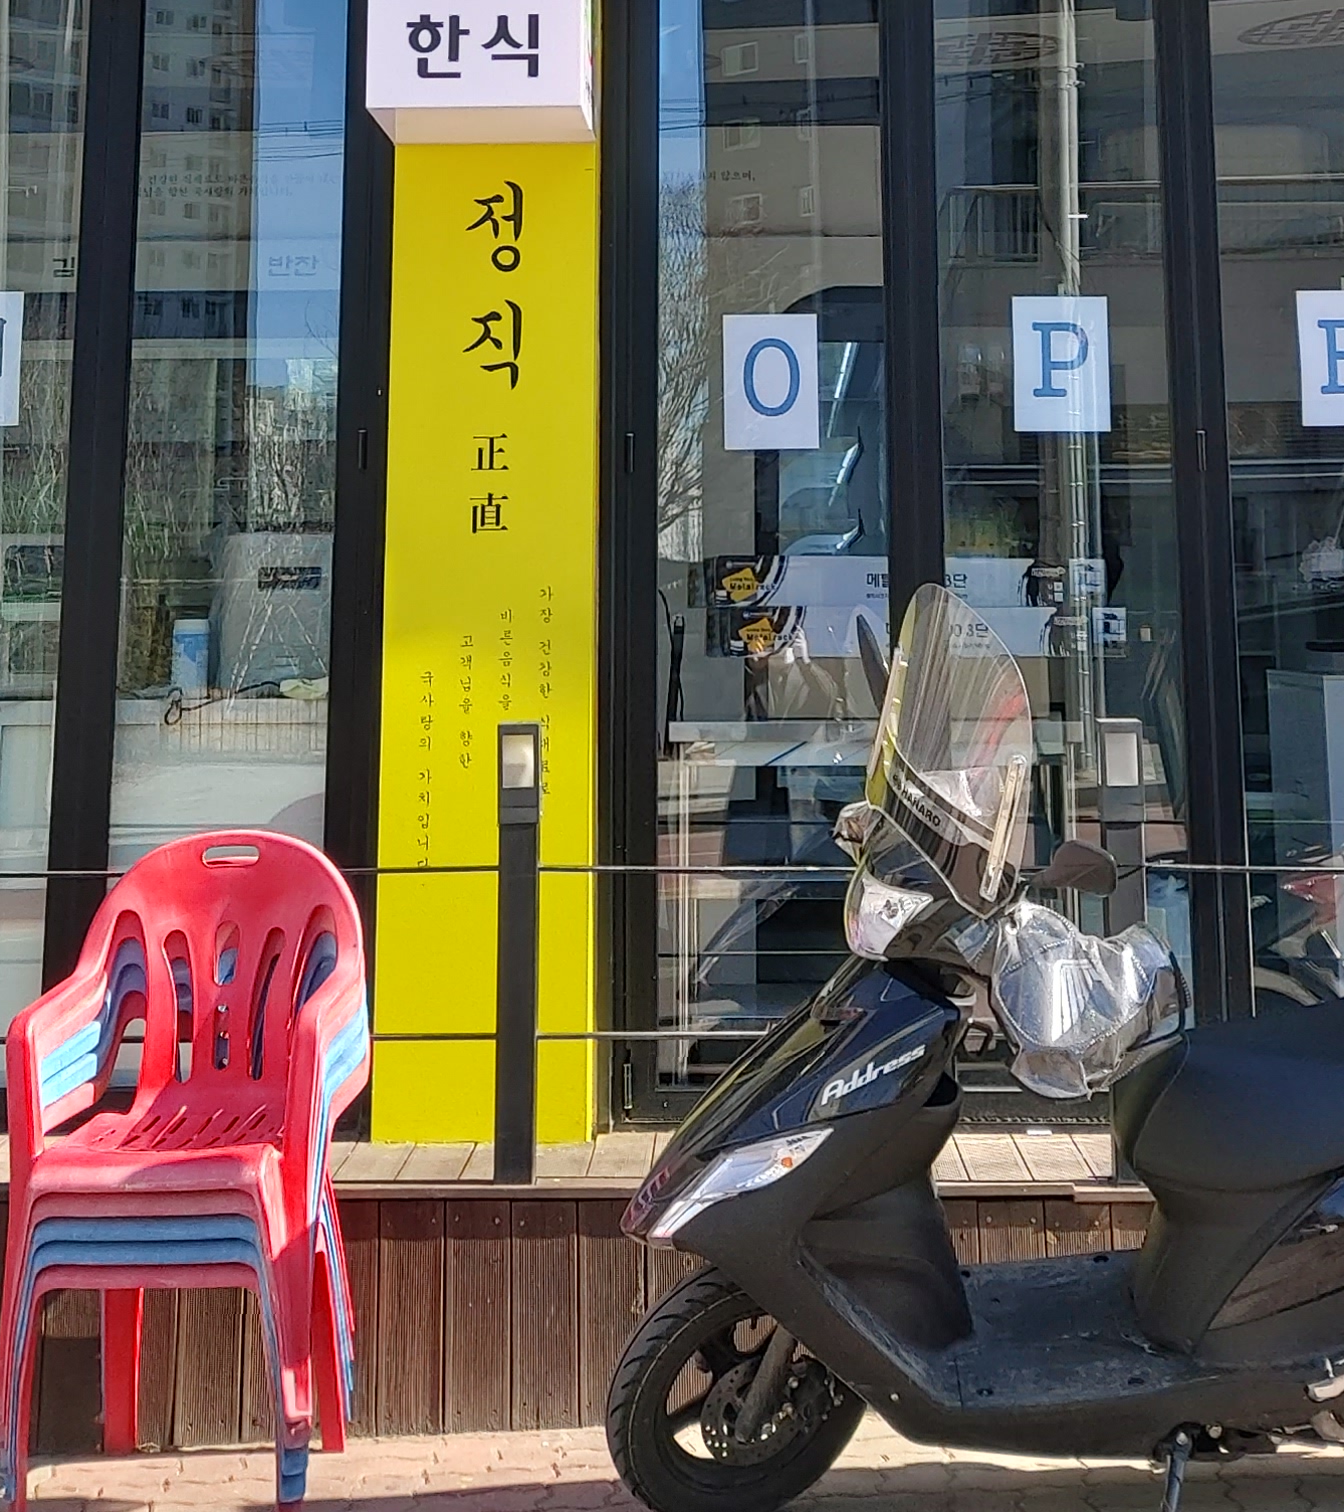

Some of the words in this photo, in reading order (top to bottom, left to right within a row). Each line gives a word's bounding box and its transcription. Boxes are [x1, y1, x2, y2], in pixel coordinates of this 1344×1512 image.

[406, 13, 540, 79] 한식
[463, 180, 524, 391] 정직
[470, 434, 509, 534] 正直
[539, 585, 555, 624] 가장
[459, 635, 474, 714] 고객님을
[538, 639, 553, 699] 건강한
[459, 730, 473, 769] 향한
[820, 1043, 927, 1106] Address
